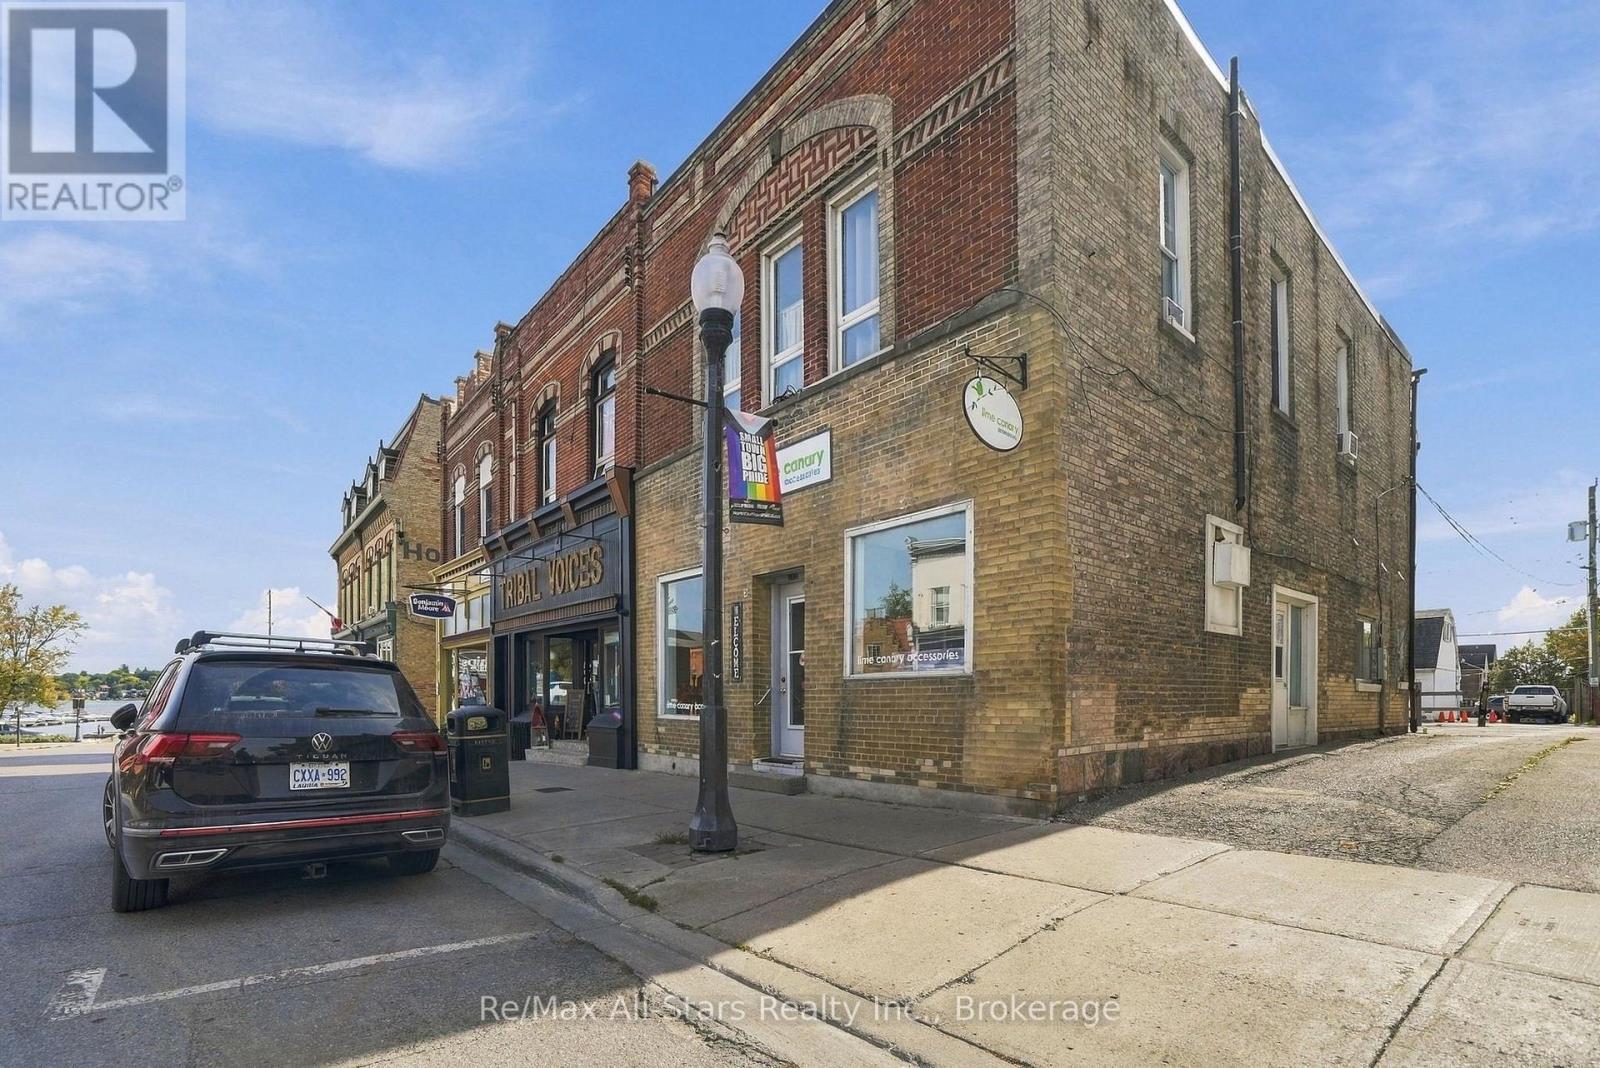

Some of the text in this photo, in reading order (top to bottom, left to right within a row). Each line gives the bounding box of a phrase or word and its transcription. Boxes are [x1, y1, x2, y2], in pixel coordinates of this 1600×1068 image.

[739, 432, 764, 446] SMALL
[741, 441, 766, 456] TOWN
[741, 451, 767, 473] BIG
[783, 450, 825, 475] canary
[743, 470, 769, 484] PRIDE
[784, 467, 821, 486] accessories
[500, 543, 605, 610] TRIBAL VOICES
[413, 597, 444, 607] Benjamin
[417, 603, 440, 612] Moore
[857, 650, 960, 666] lime canary accessories
